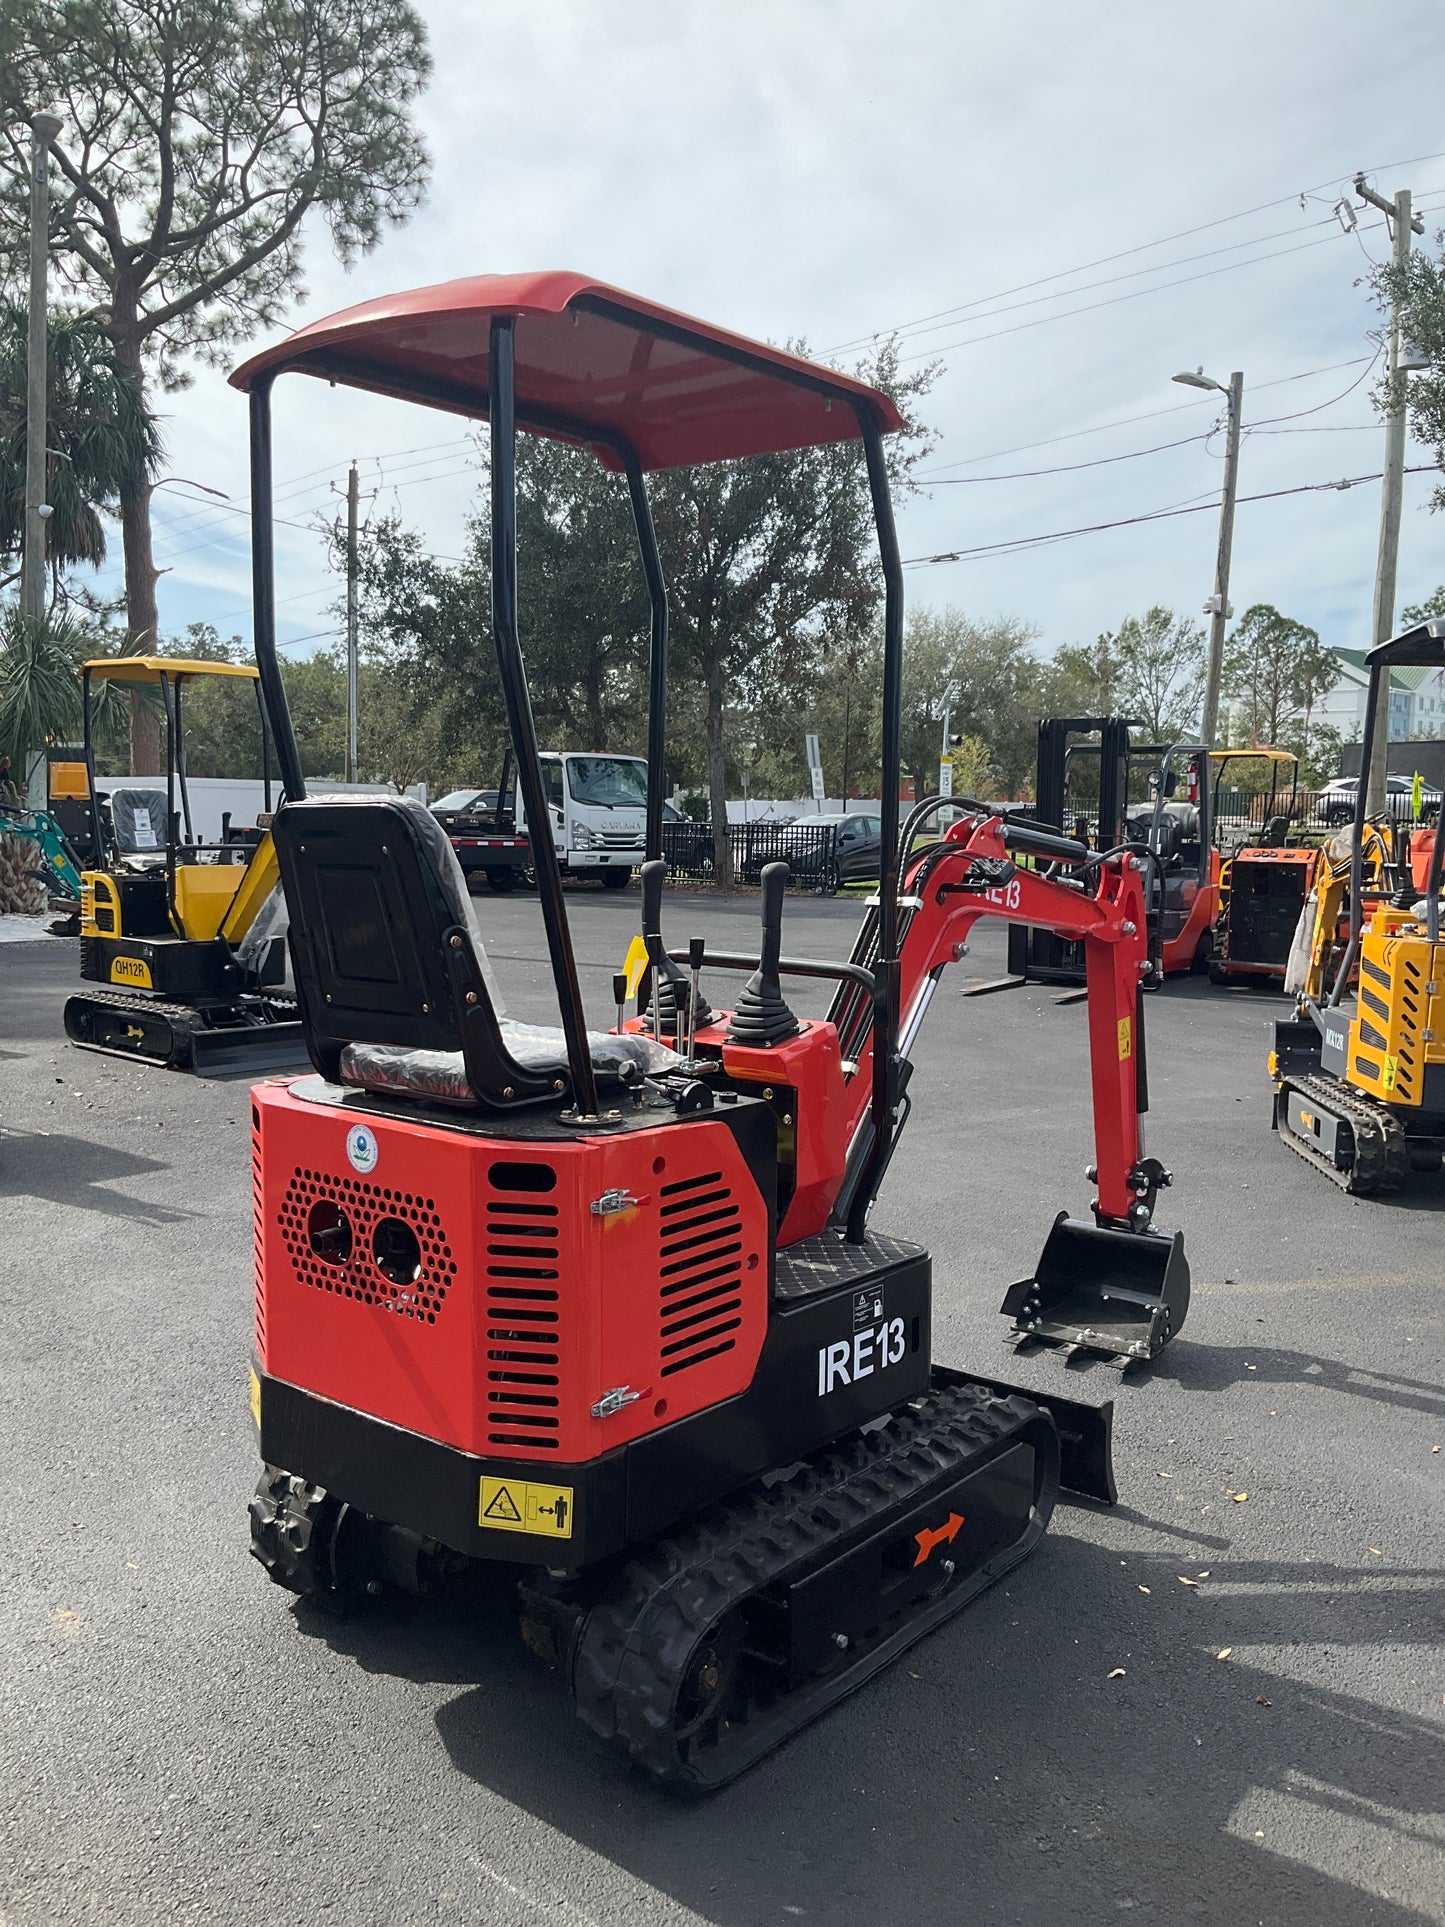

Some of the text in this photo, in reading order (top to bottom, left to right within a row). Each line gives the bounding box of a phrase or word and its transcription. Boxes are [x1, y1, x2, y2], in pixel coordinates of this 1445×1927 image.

[943, 777, 950, 786] 15
[115, 960, 145, 978] QH12R
[1326, 1028, 1344, 1052] MX12R
[818, 1317, 906, 1397] IRE13
